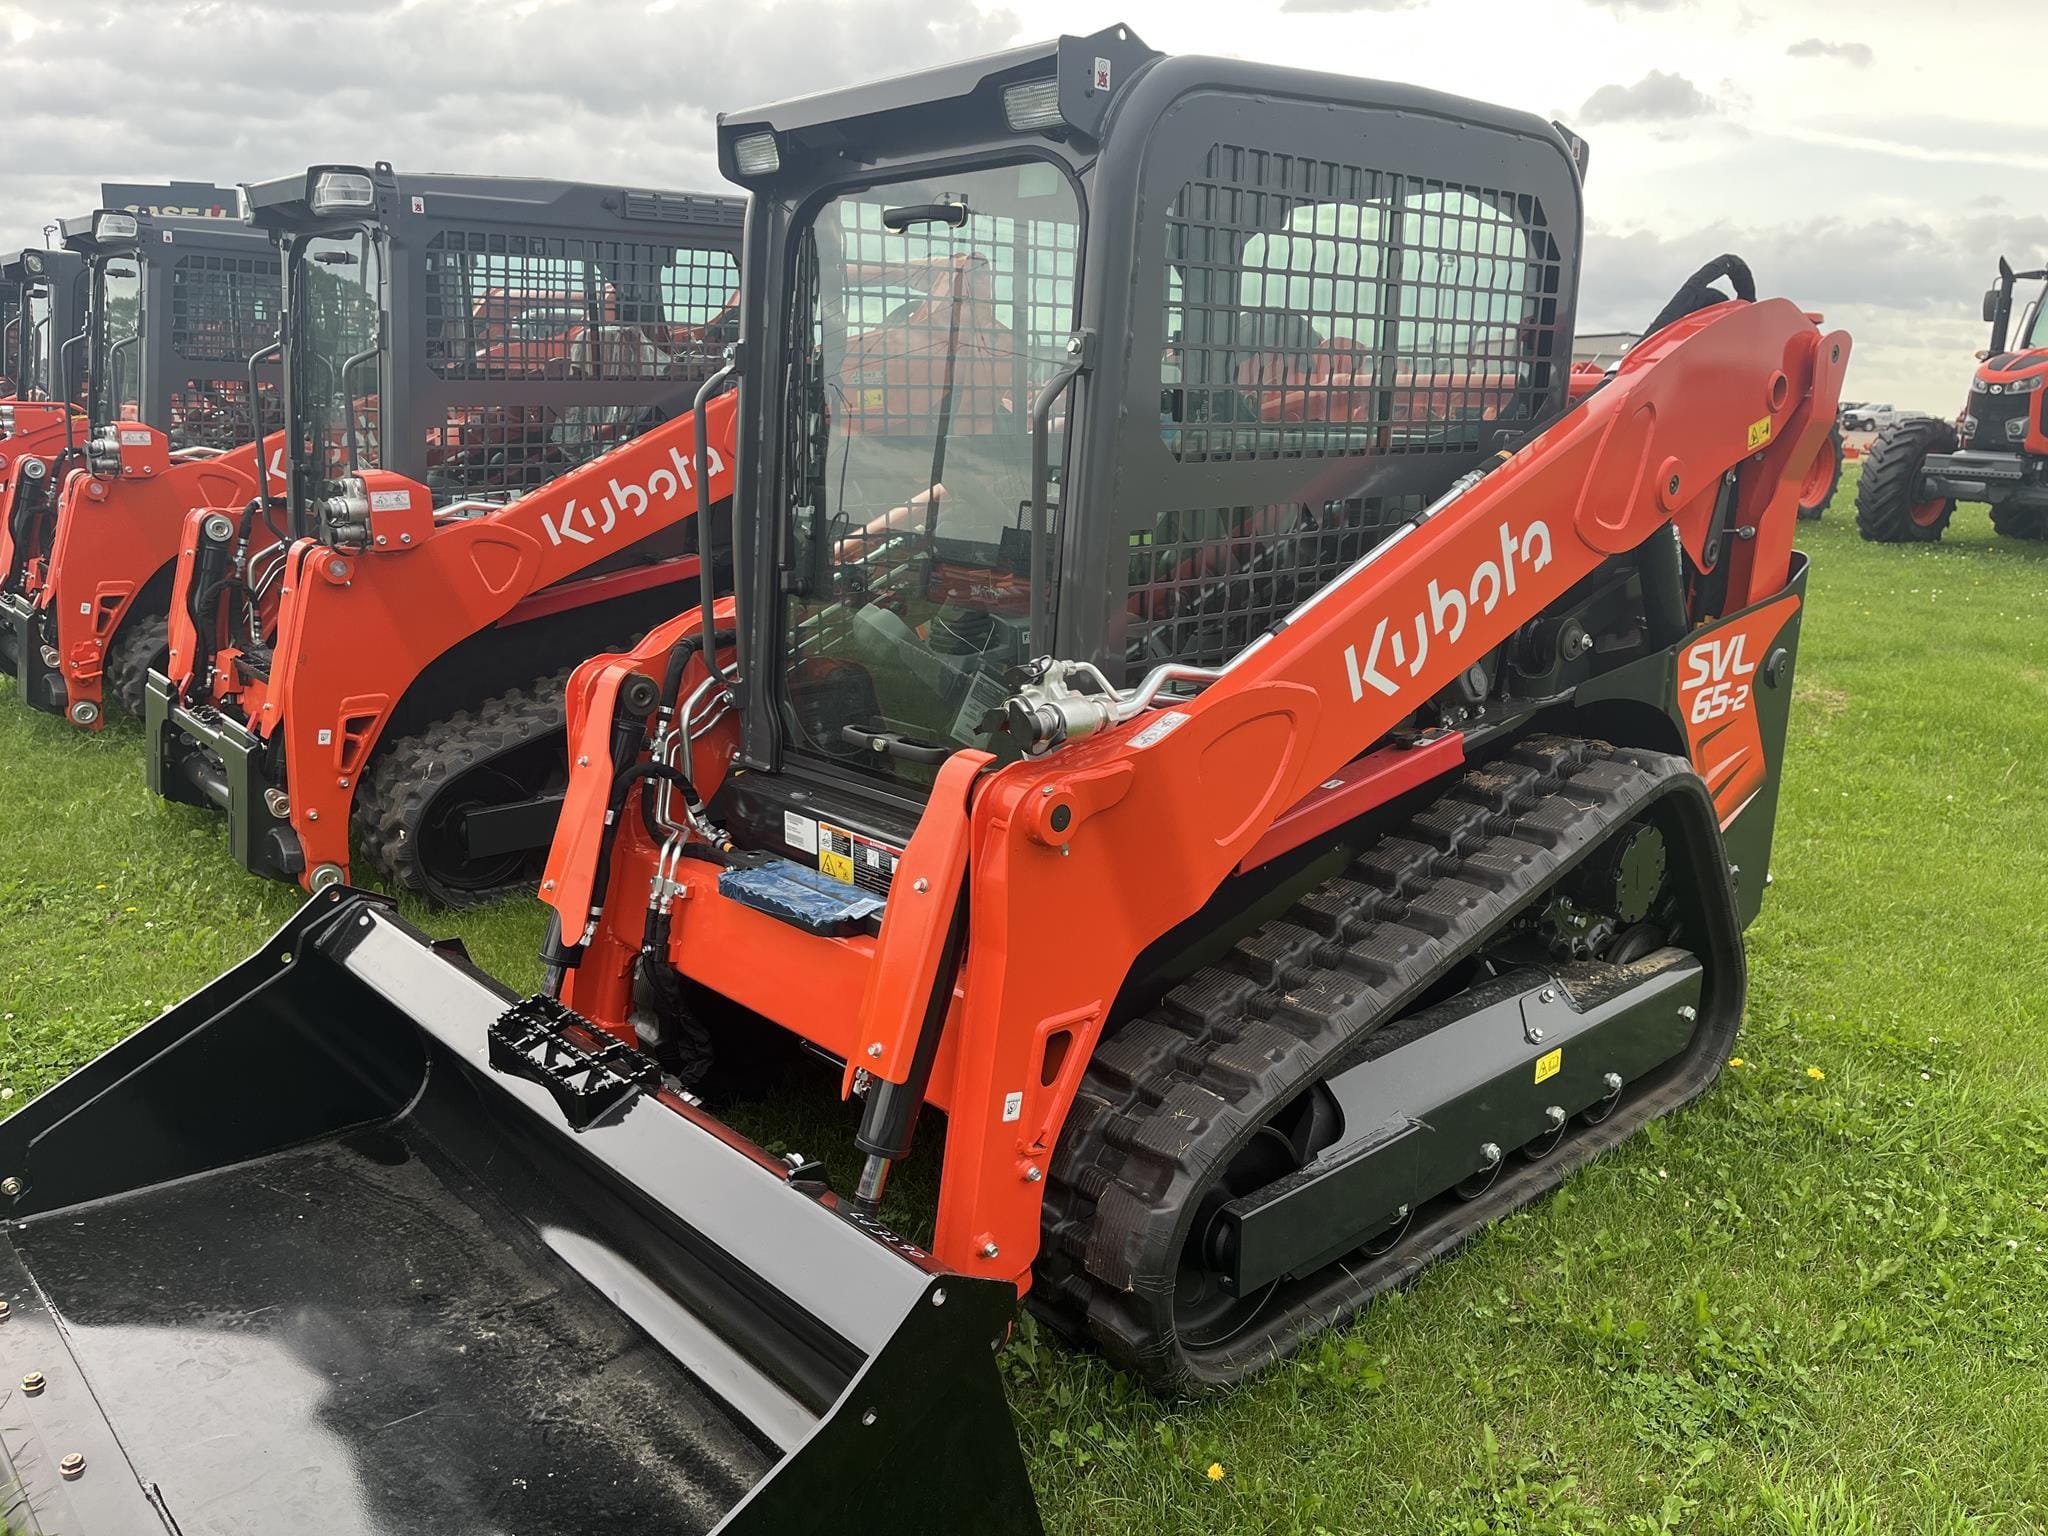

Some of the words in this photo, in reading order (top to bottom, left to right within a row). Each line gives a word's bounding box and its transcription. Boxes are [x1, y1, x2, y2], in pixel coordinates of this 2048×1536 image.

[541, 446, 726, 547] Kubota
[1343, 519, 1553, 704] Kubota
[1681, 633, 1755, 691] SVL
[1690, 681, 1750, 725] 65-2
